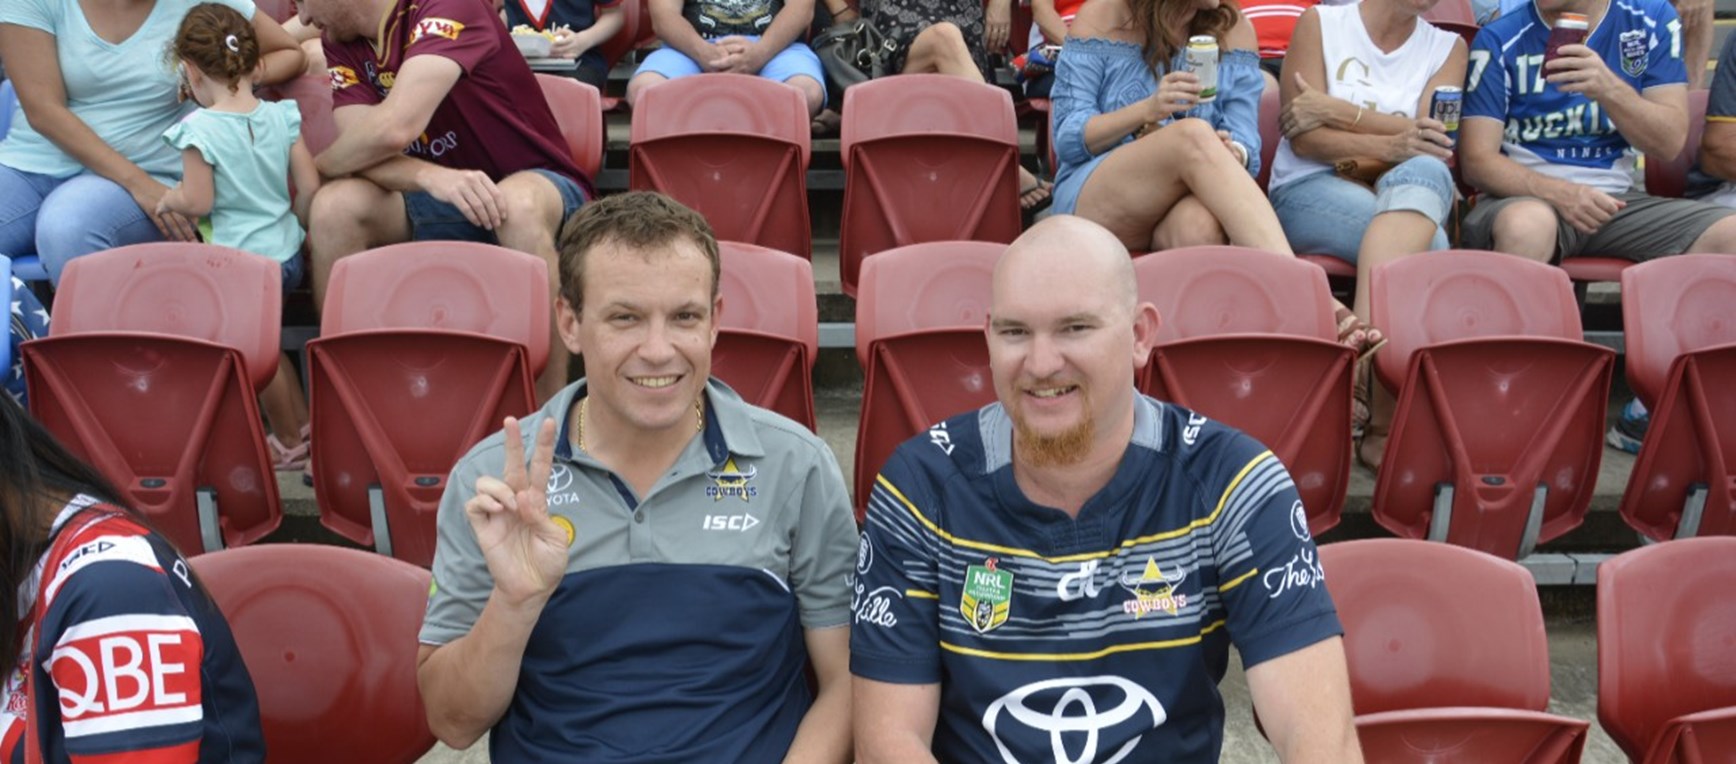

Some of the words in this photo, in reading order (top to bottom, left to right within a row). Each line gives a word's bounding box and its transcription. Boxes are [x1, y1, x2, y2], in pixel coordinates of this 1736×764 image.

[1516, 54, 1547, 94] 17
[1504, 101, 1617, 144] AUCKL
[1557, 147, 1613, 159] NINES
[546, 492, 580, 506] YOTA
[705, 486, 758, 497] COWBOYS
[973, 571, 1006, 590] NRL
[1263, 554, 1311, 599] The
[1123, 594, 1187, 614] COWBOYS
[51, 633, 187, 719] QBE
